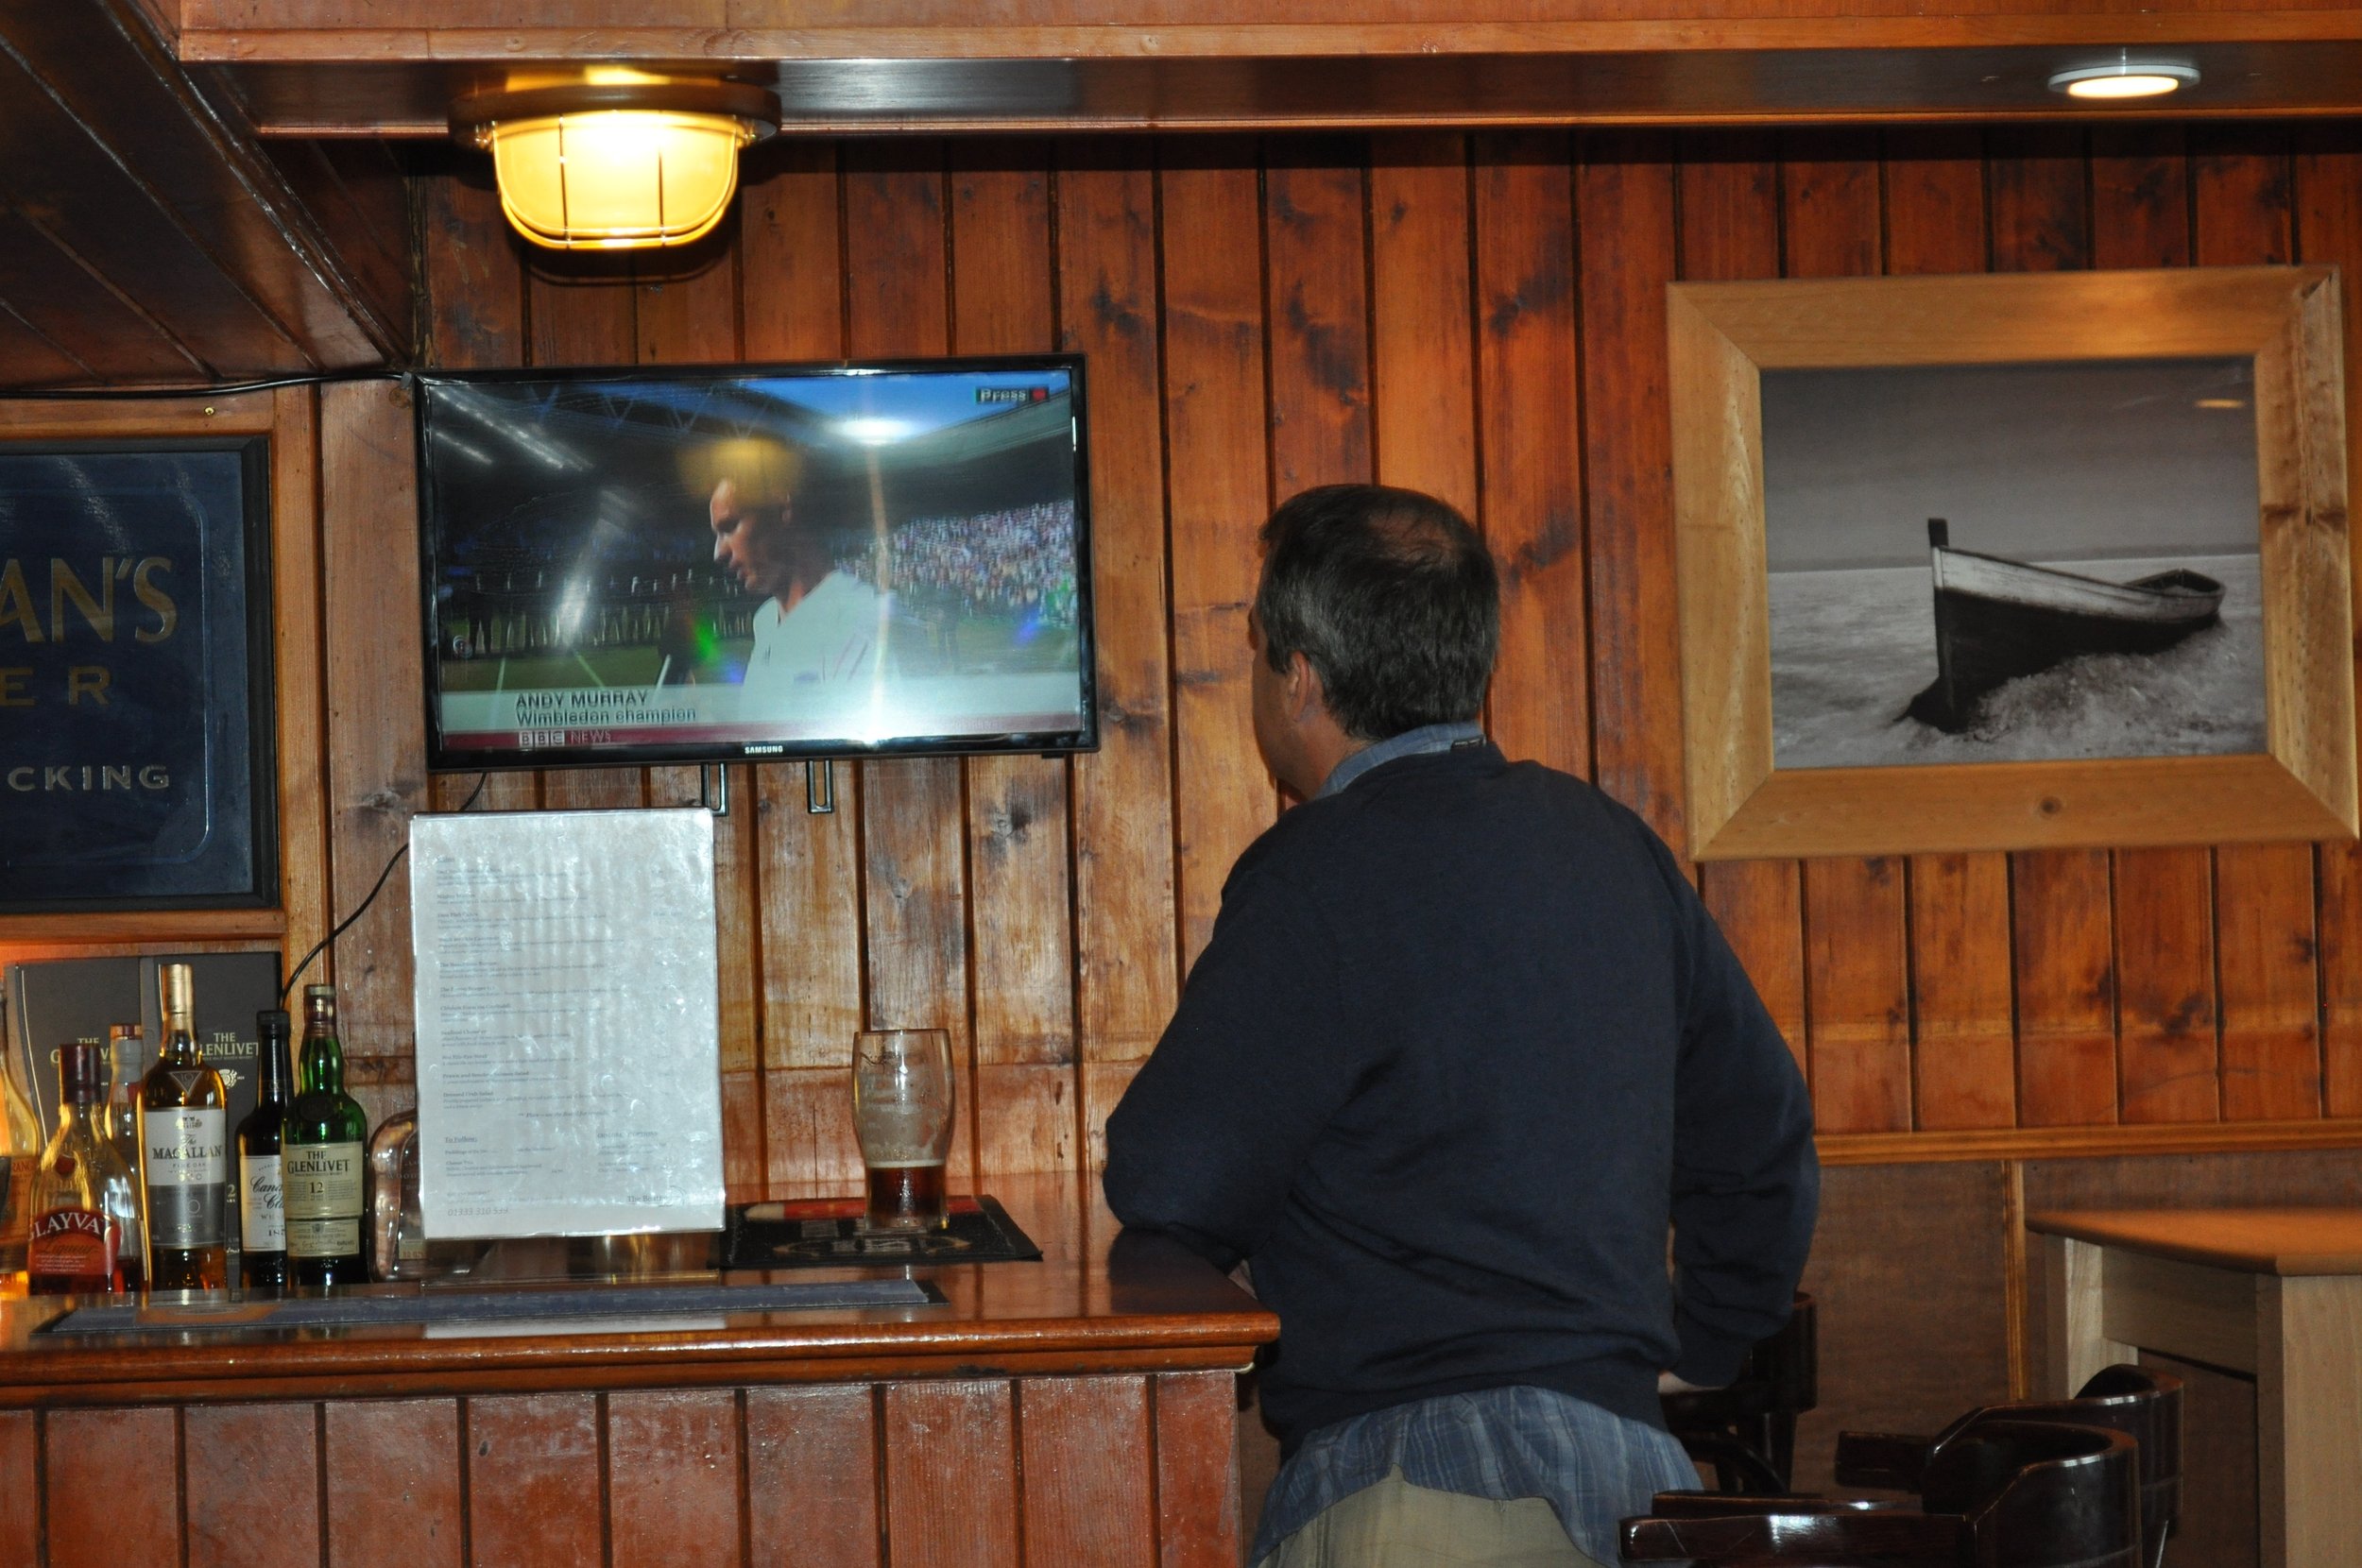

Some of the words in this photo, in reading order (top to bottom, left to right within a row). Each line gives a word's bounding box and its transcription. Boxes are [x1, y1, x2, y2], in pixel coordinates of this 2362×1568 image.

[980, 387, 1026, 403] Press
[516, 691, 565, 709] ANDY
[571, 689, 648, 708] MURRAY
[516, 708, 609, 727] Wimbledon
[615, 707, 696, 725] champion
[520, 729, 566, 747] BBC
[570, 729, 612, 743] NEWS
[745, 745, 783, 755] SAMSUNG
[214, 1031, 236, 1043] THE
[199, 1042, 259, 1057] LENLIVET
[152, 1146, 223, 1161] MACALLAN
[306, 1150, 326, 1160] THE
[287, 1158, 351, 1174] GLENLIVET
[309, 1181, 324, 1194] 12
